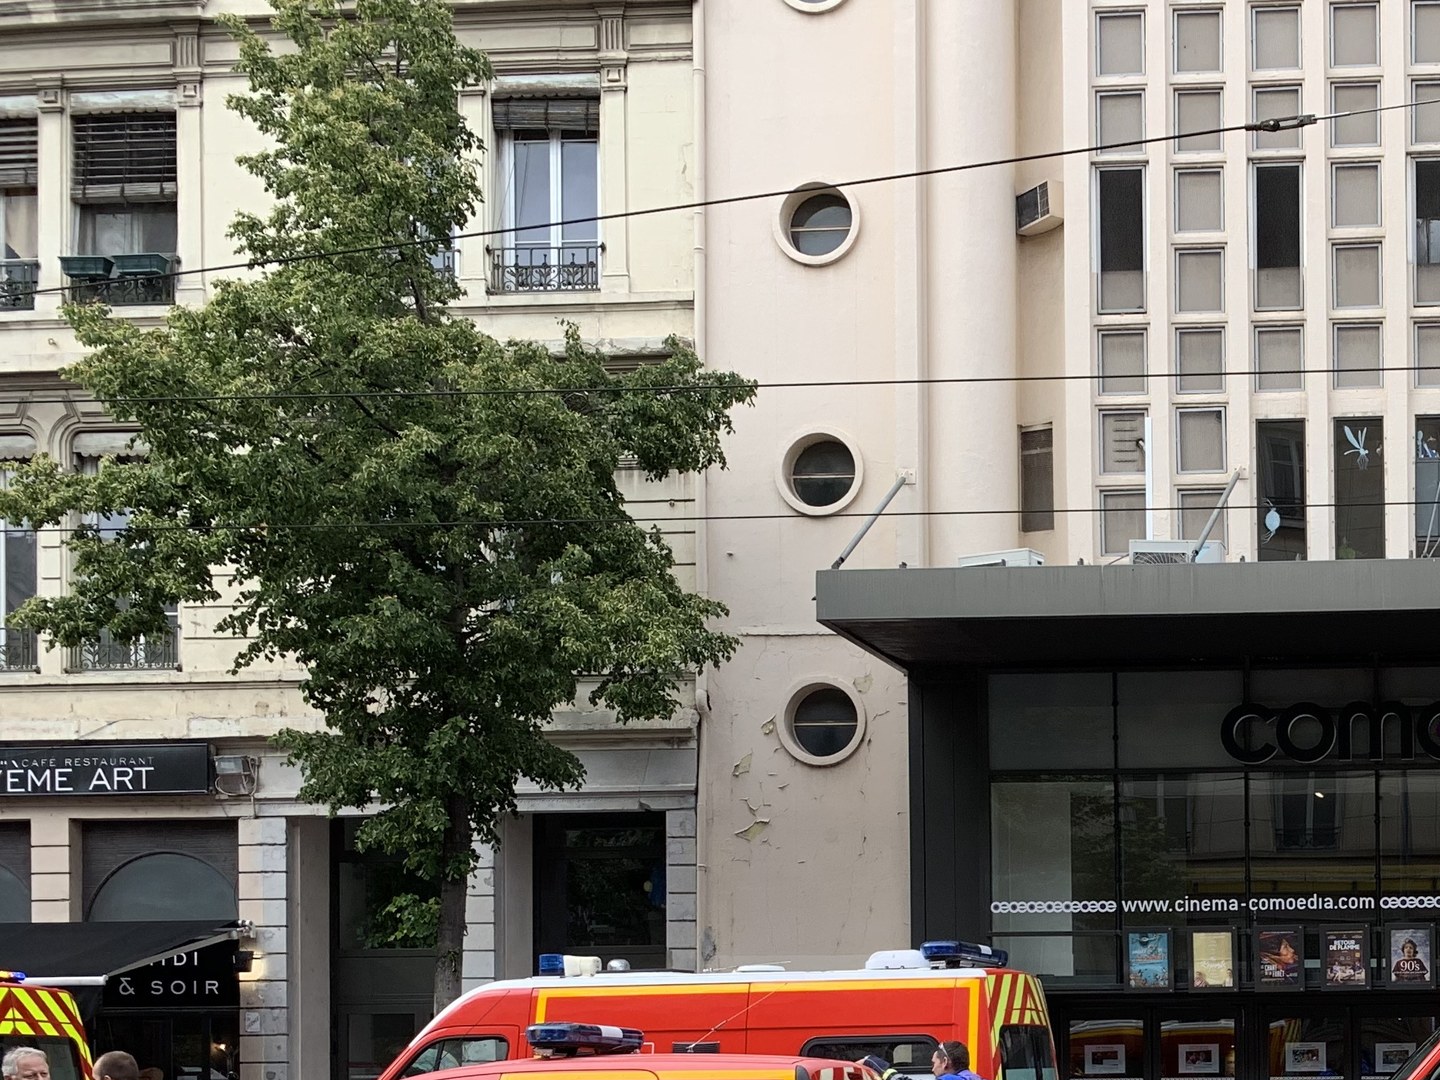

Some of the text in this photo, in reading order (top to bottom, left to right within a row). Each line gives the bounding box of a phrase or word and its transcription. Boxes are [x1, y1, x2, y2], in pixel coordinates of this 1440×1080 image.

[64, 756, 154, 766] RESTAURANT
[0, 760, 155, 792] ÈME ART
[1400, 960, 1420, 972] 90's
[120, 978, 219, 995] & SOIR
